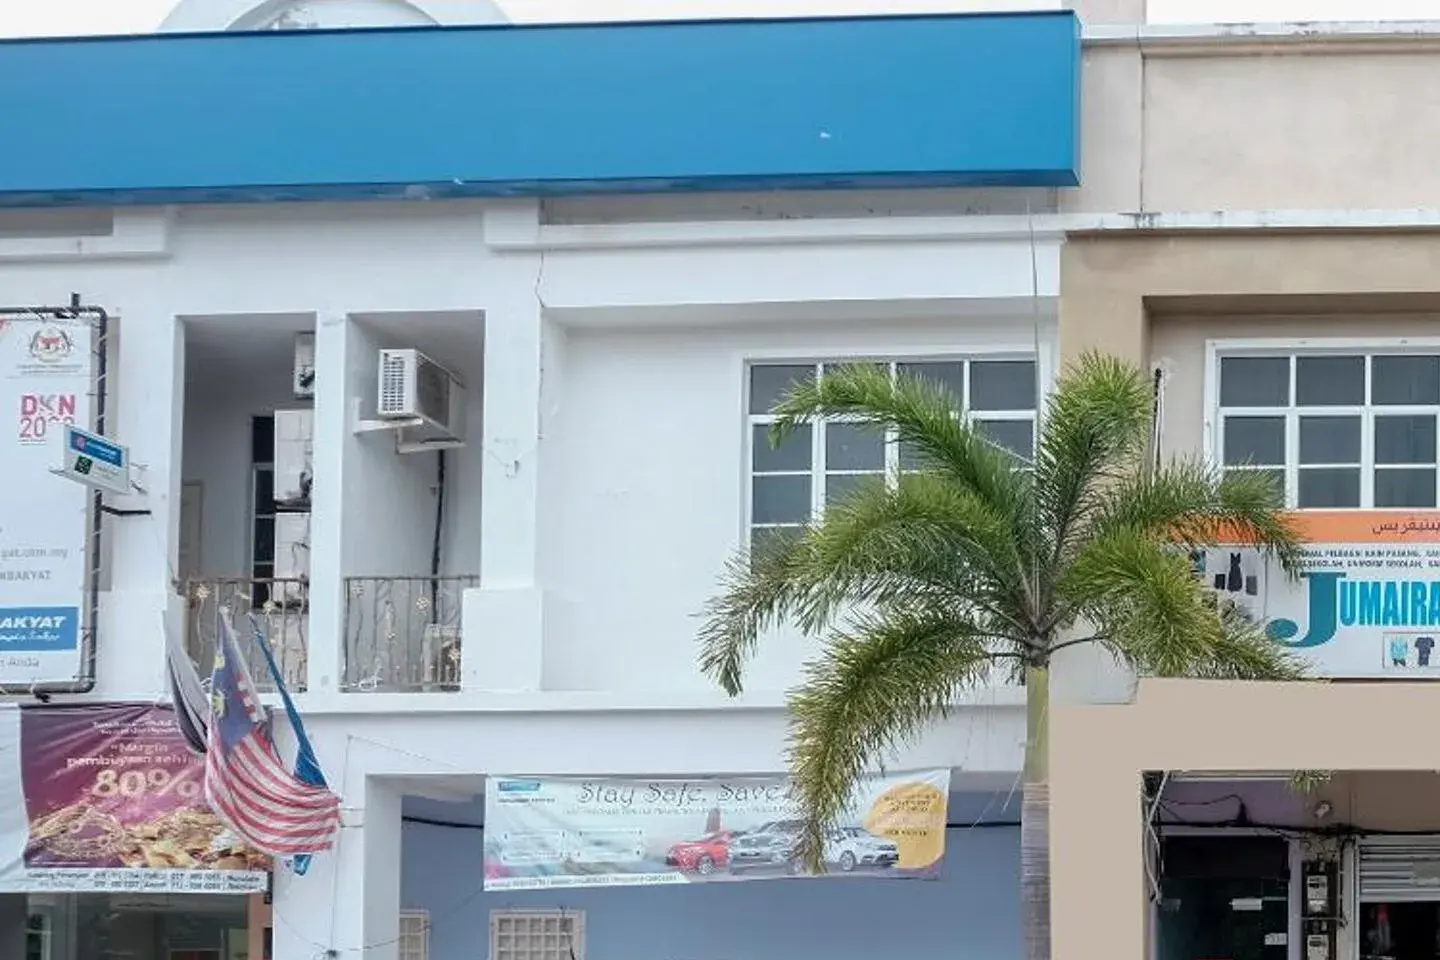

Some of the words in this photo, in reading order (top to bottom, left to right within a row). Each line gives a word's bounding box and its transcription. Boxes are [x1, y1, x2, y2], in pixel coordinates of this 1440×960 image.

[19, 416, 75, 438] 20
[92, 768, 201, 799] 80%
[578, 783, 635, 807] Stay
